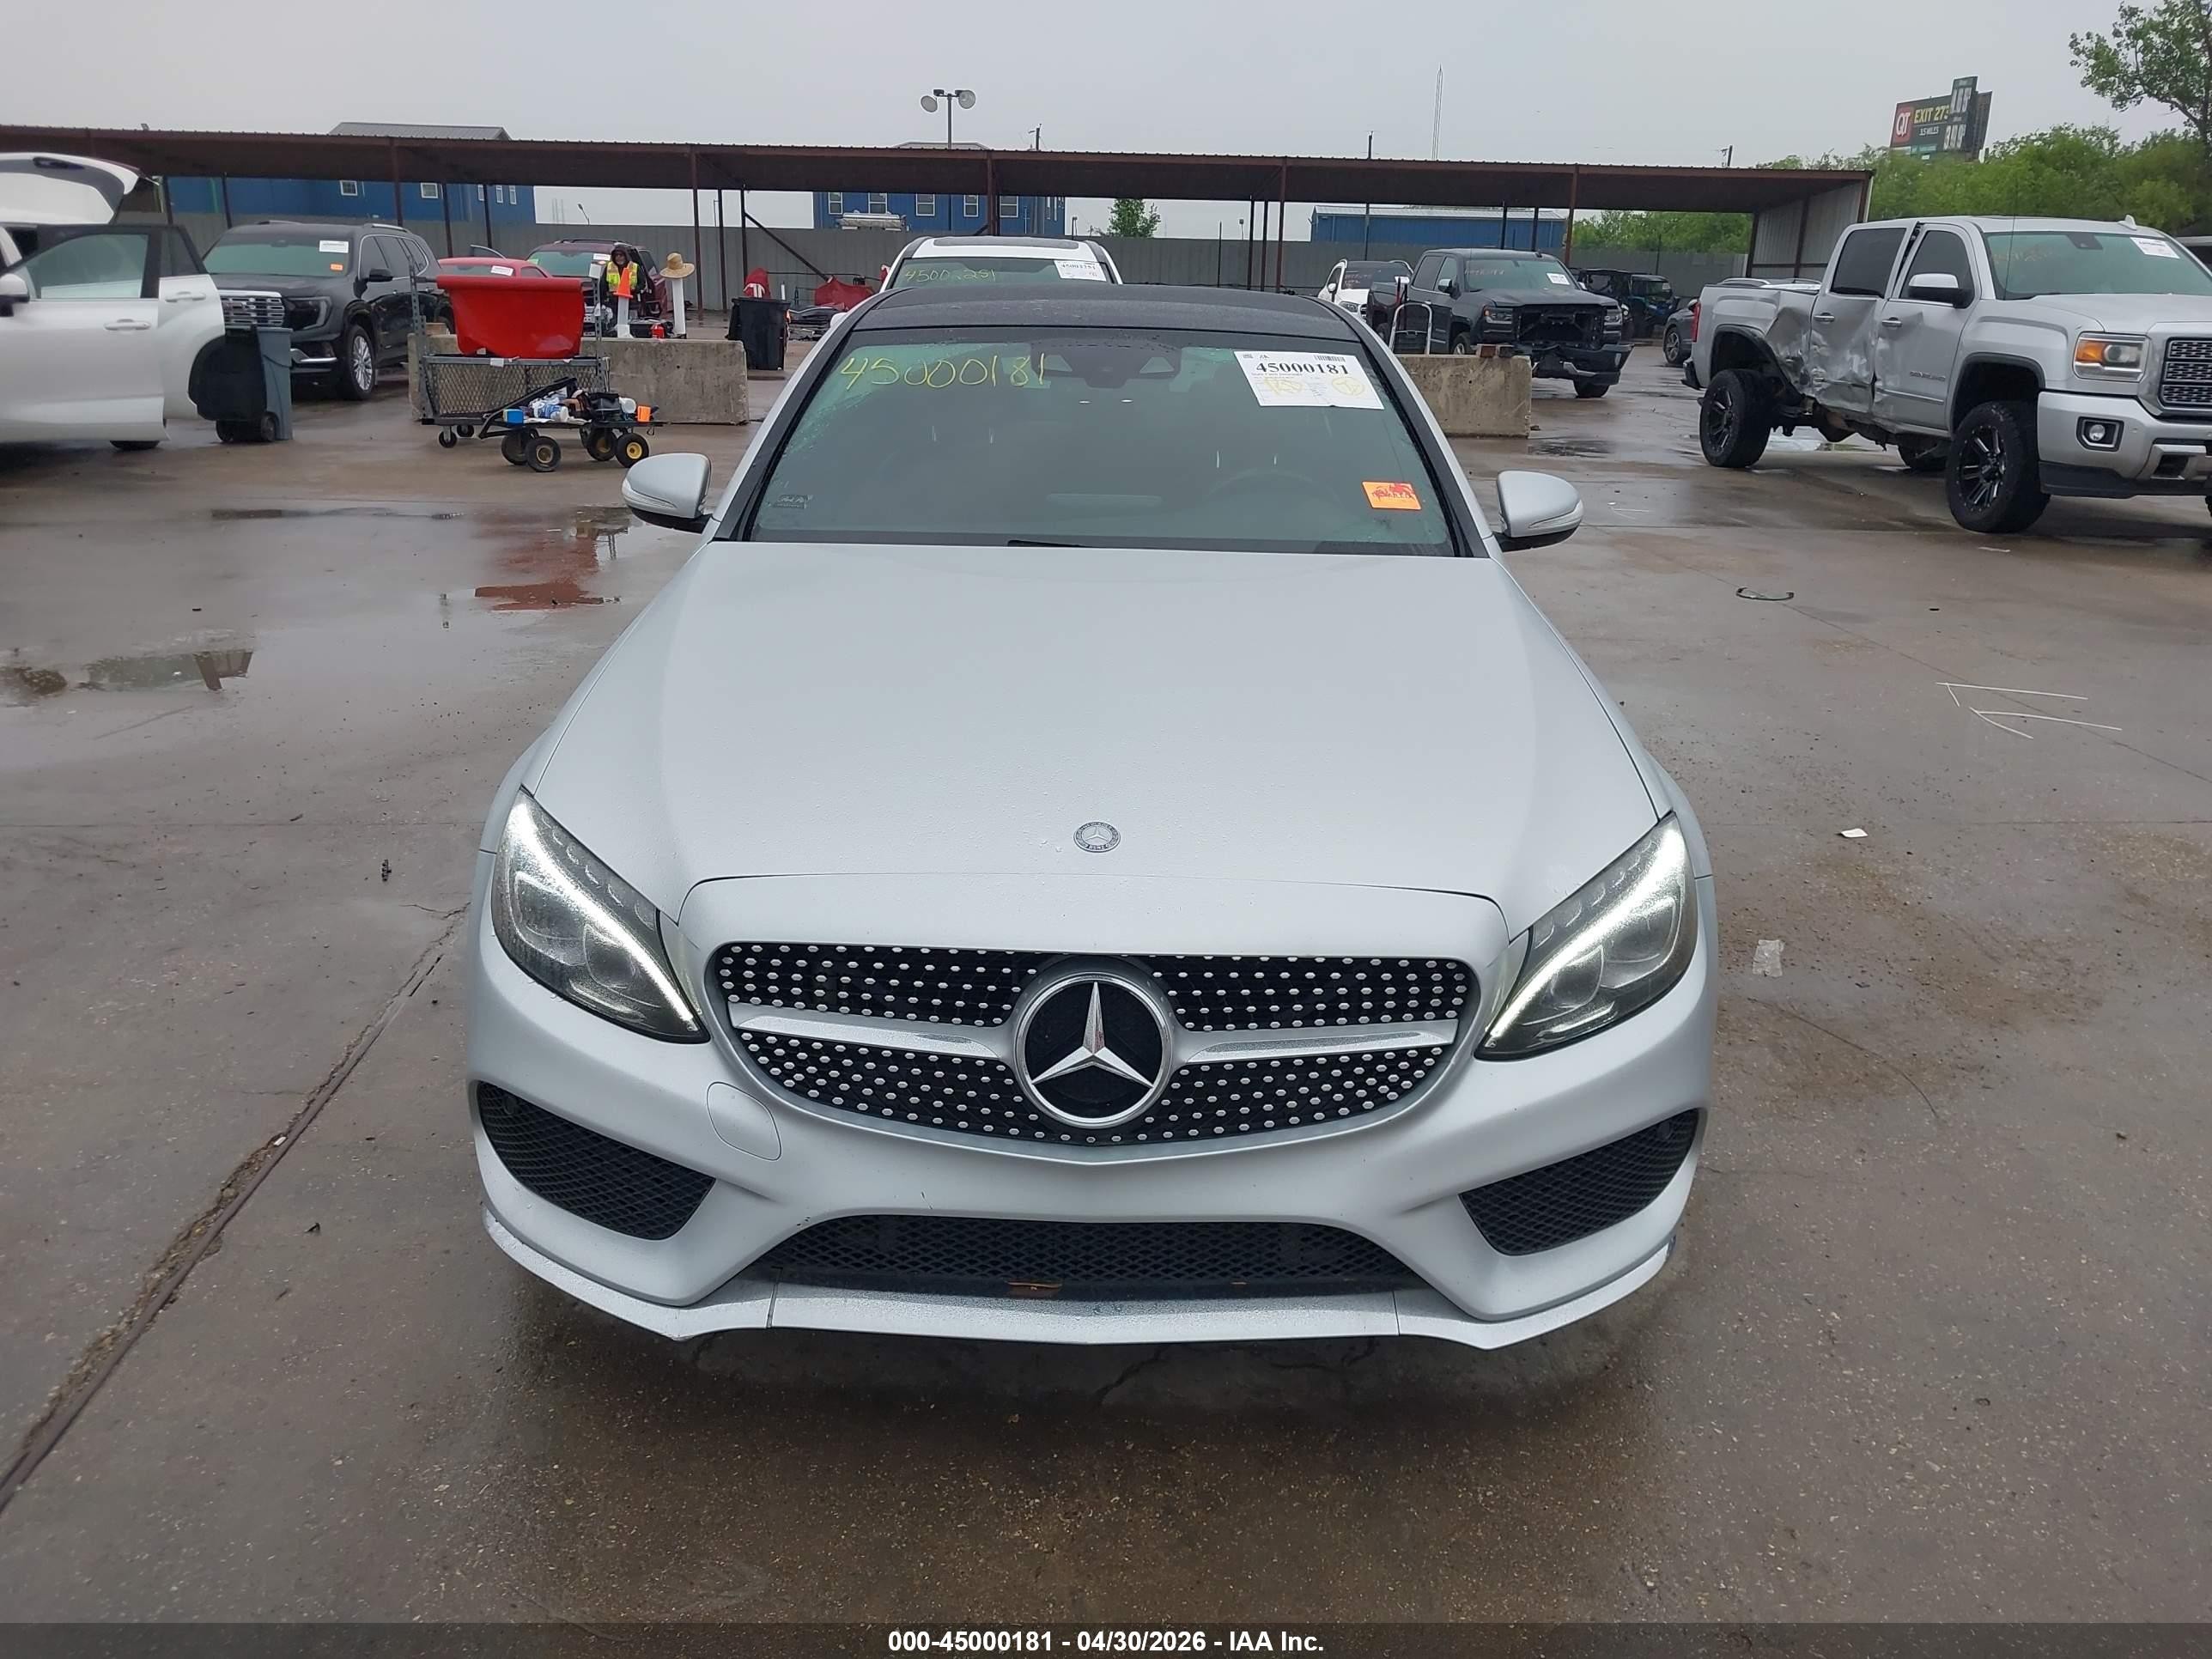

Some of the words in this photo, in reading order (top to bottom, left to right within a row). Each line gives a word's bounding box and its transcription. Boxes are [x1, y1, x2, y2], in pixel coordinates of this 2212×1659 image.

[1896, 112, 1911, 137] QT
[1914, 107, 1934, 124] EXIT
[840, 352, 1046, 391] 45000181
[1256, 362, 1349, 374] 45000181
